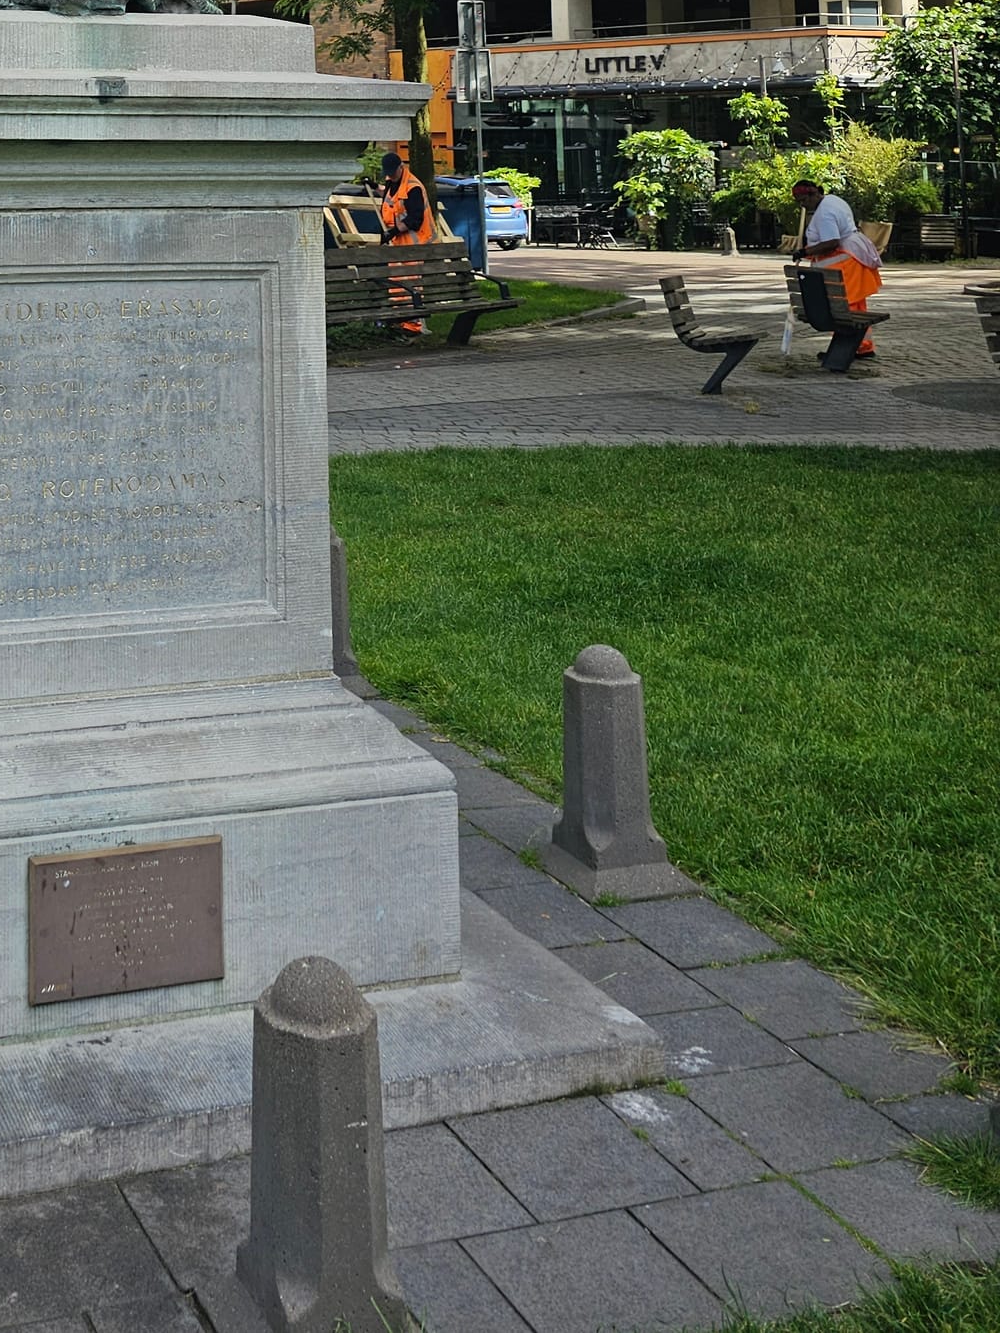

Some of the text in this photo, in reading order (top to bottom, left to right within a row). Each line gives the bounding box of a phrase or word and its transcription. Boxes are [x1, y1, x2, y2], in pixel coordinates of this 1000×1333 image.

[585, 54, 665, 73] LITTLE V
[119, 298, 223, 320] ERASMO
